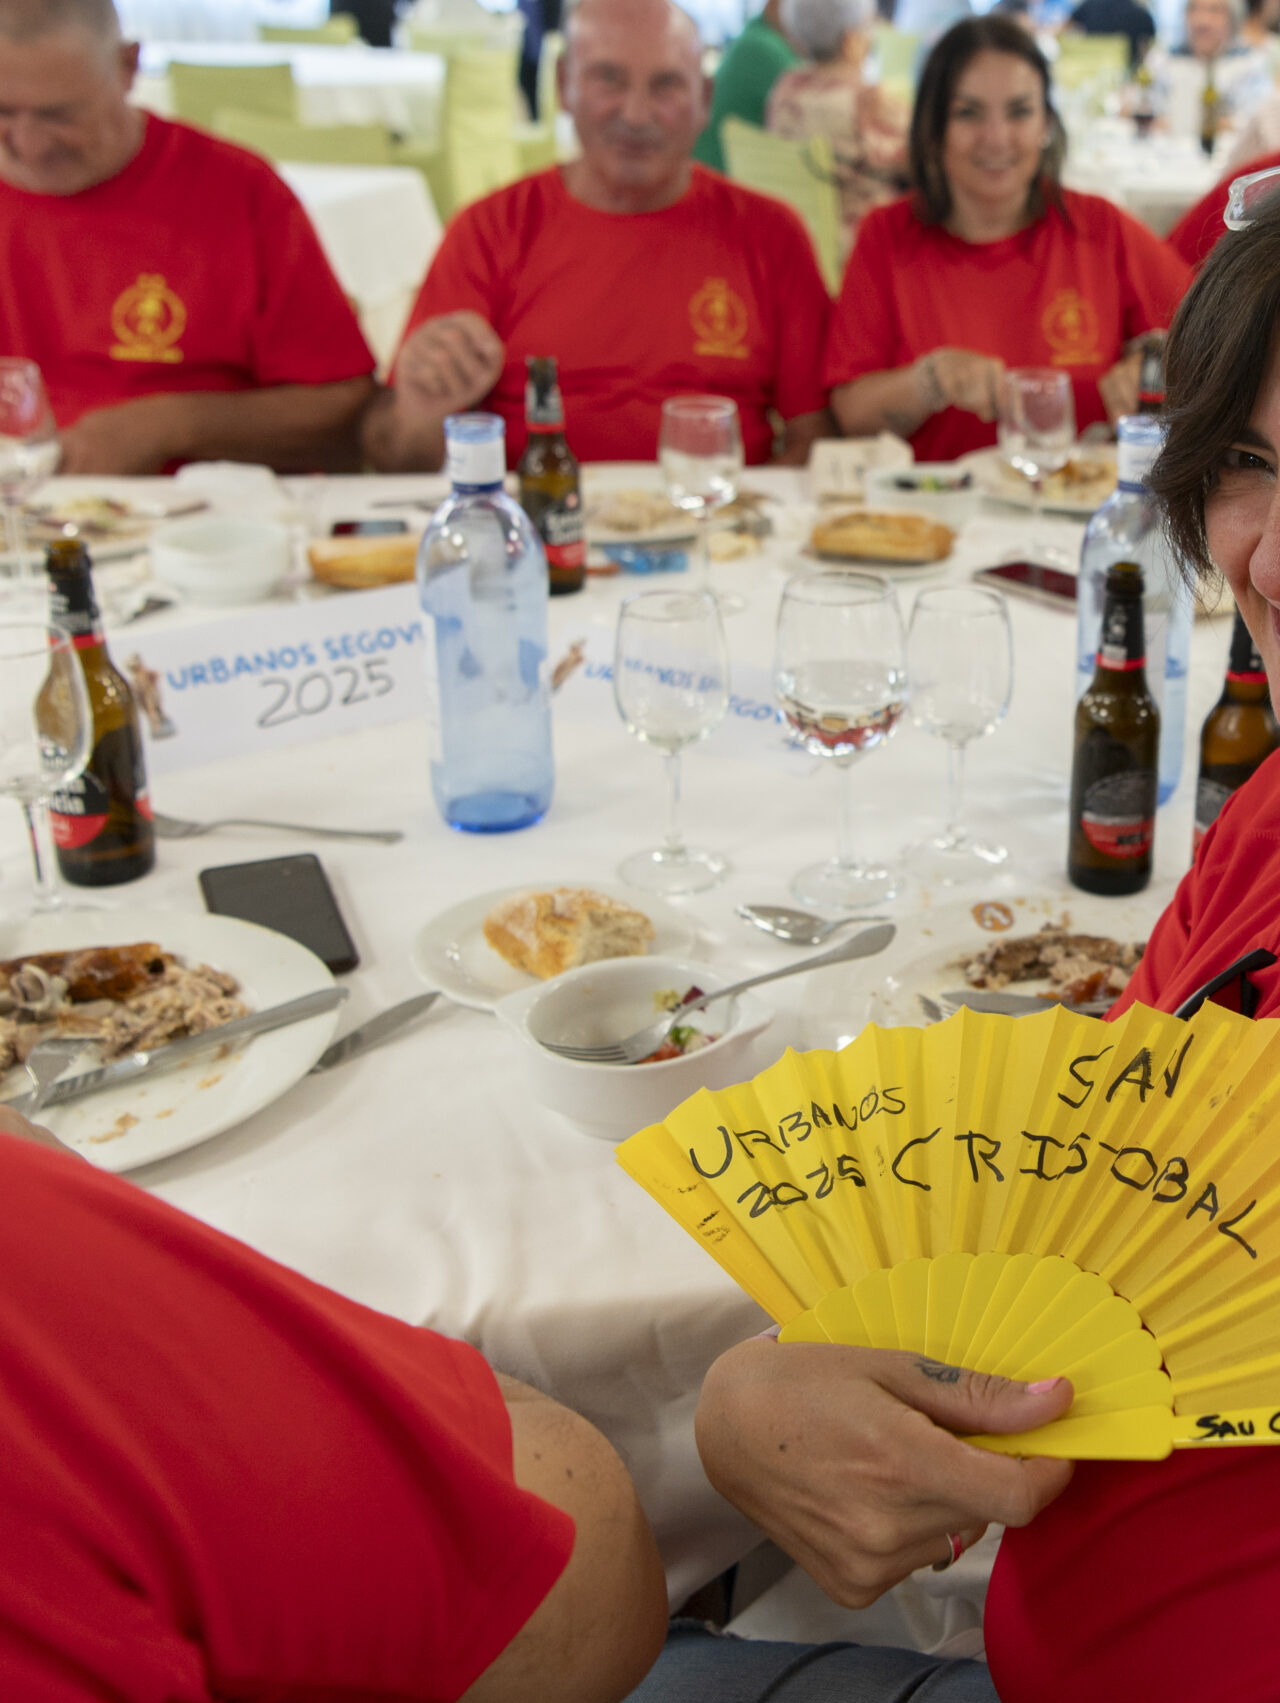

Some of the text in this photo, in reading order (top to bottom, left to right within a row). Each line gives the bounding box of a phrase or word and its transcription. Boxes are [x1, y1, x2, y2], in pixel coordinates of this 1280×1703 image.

[167, 642, 317, 690] URBANOS
[256, 657, 394, 729] 2025
[689, 1086, 906, 1179] URBANOS
[737, 1154, 867, 1218] 2025
